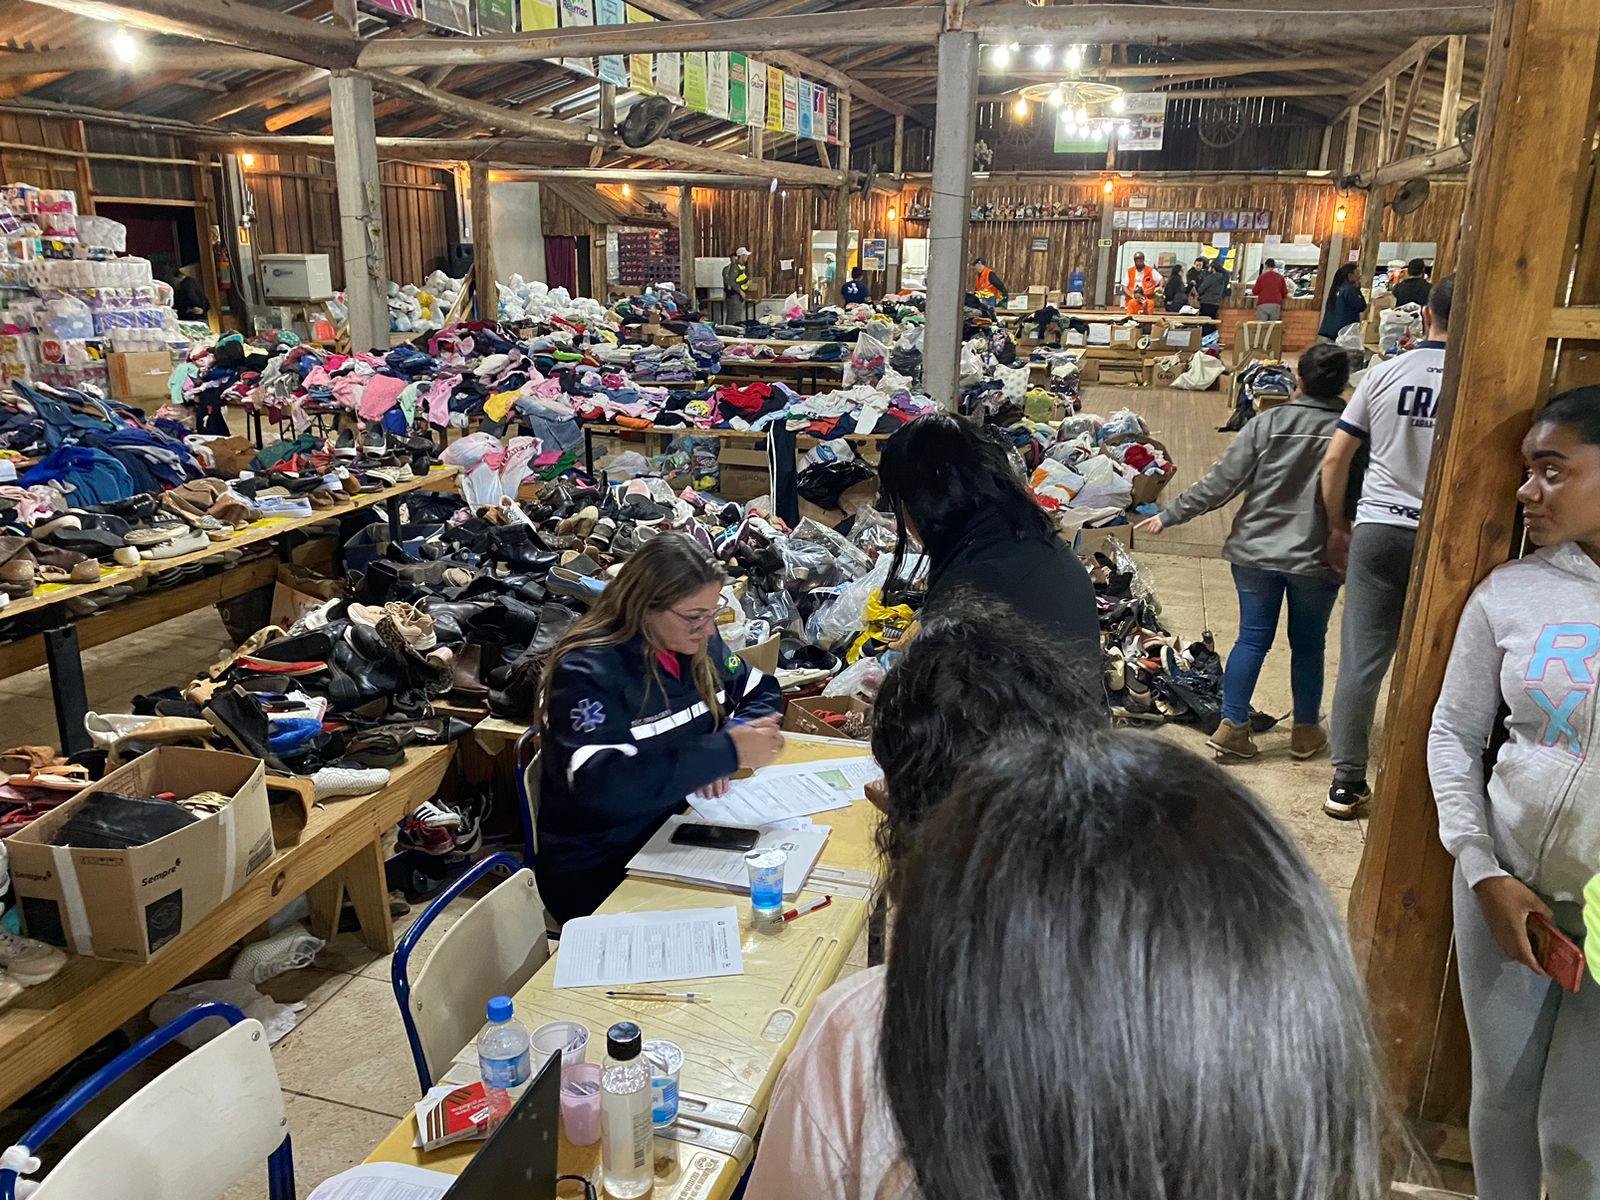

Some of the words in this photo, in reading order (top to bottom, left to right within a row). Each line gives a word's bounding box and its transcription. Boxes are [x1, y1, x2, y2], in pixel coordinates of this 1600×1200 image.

[1524, 621, 1600, 685] R
[1523, 686, 1592, 760] X
[141, 866, 177, 887] Sempre
